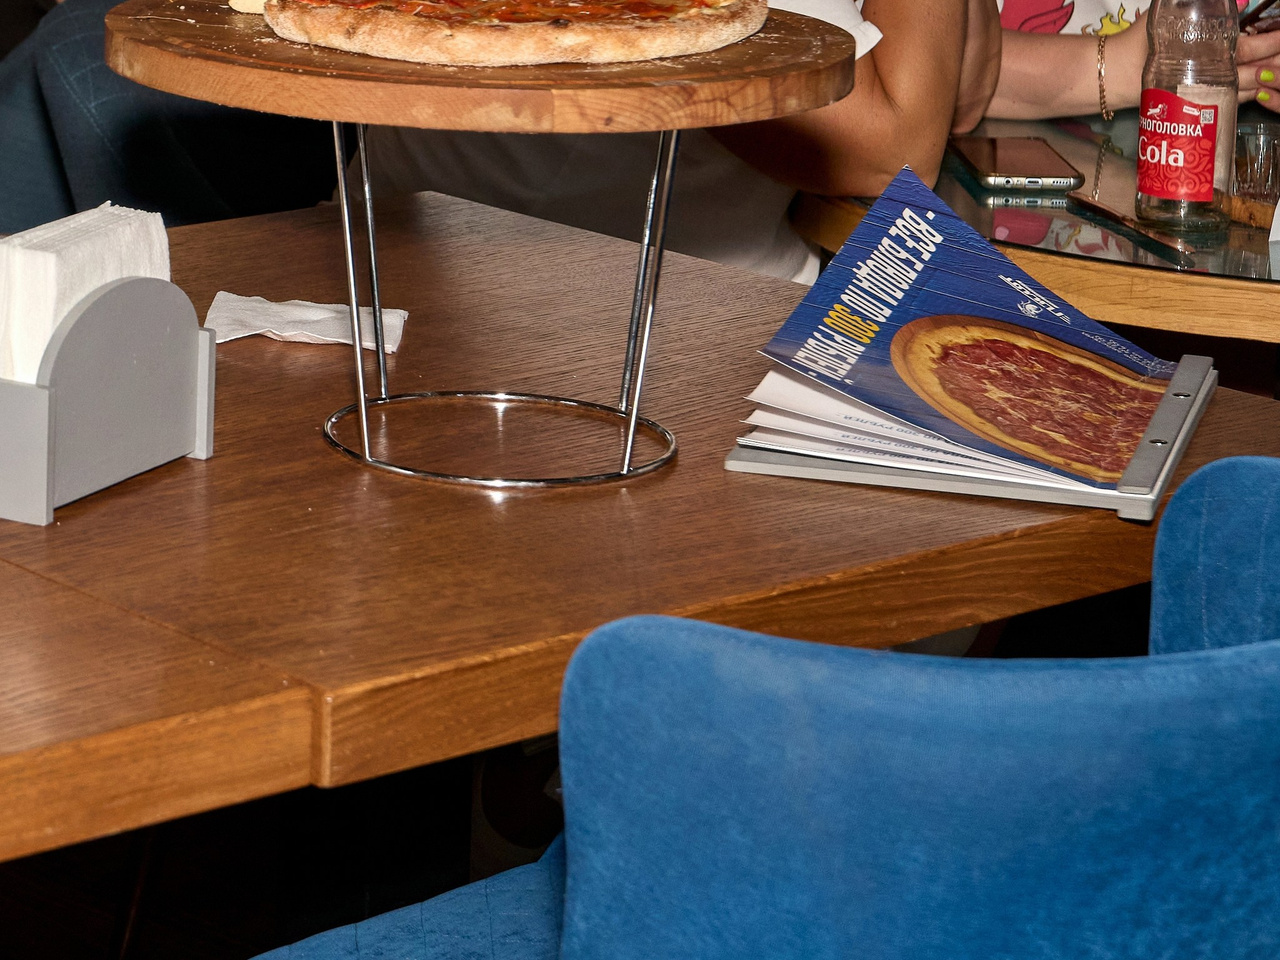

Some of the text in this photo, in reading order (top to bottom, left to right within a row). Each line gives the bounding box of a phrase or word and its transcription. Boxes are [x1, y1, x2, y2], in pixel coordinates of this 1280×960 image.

[1138, 135, 1185, 168] Cola
[791, 207, 944, 385] ВСЕ БЛЮДА ПО 300 РУБЛЕЙ
[998, 274, 1069, 323] ПИЛОТ
